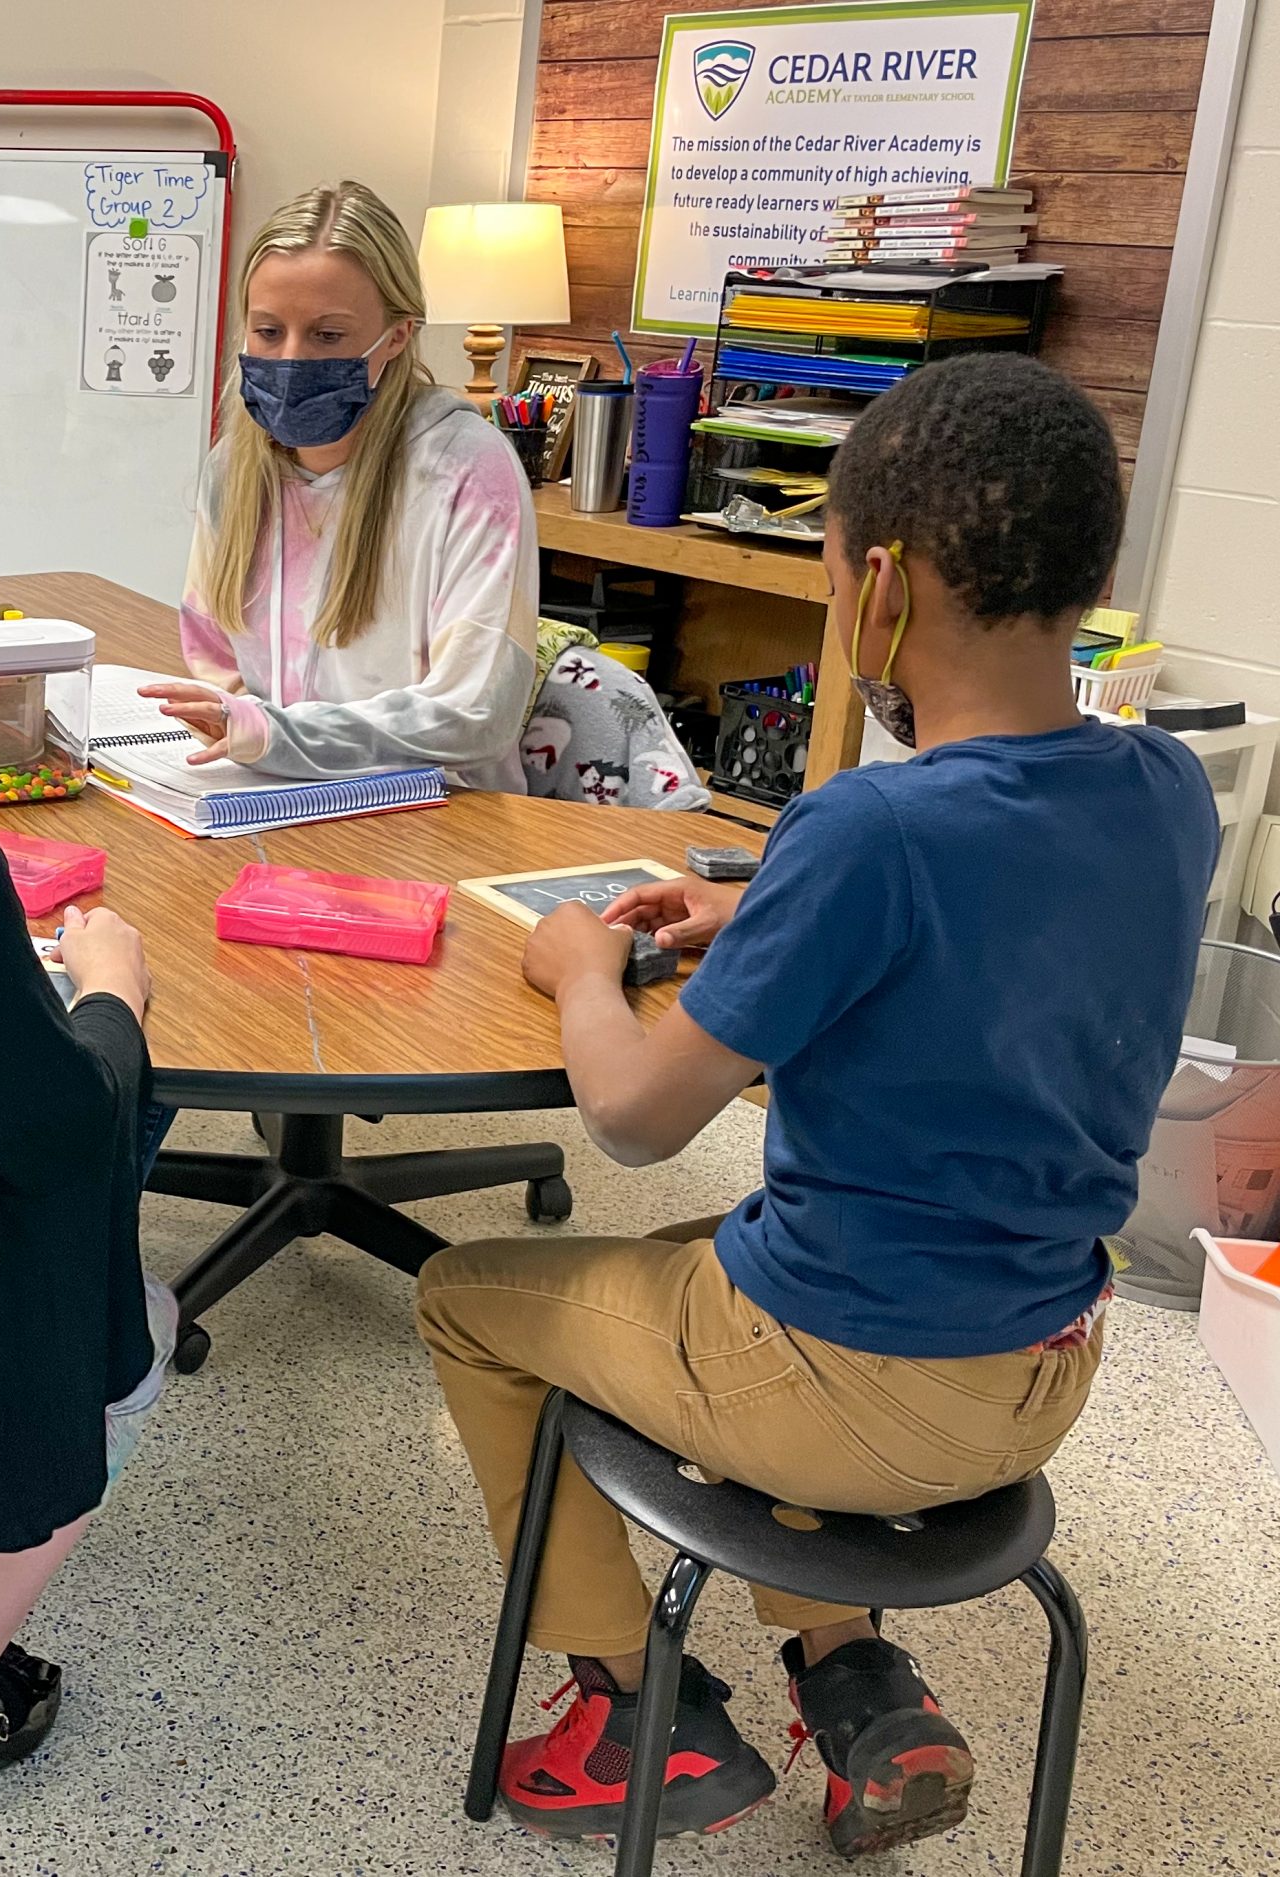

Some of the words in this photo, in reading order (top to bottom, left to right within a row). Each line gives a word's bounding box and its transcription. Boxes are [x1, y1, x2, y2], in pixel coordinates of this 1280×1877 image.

[768, 52, 873, 84] CEDAR
[881, 49, 978, 81] RIVER
[765, 88, 842, 104] ACADEMY
[842, 95, 852, 103] AT
[853, 94, 884, 103] TAYLOR
[886, 93, 938, 102] ELEMENTARY
[940, 92, 976, 101] SCHOOL
[672, 136, 694, 151] The
[697, 136, 749, 151] mission
[752, 135, 767, 151] of
[770, 135, 792, 151] the
[795, 135, 840, 151] Cedar
[844, 135, 886, 151] River
[888, 135, 964, 156] Academy
[966, 134, 981, 151] is
[95, 165, 144, 195] Tiger
[153, 169, 194, 189] Time
[671, 165, 683, 180] to
[686, 165, 737, 184] develop
[740, 170, 748, 181] a
[751, 166, 833, 186] community
[836, 166, 852, 182] of
[854, 166, 887, 186] high
[100, 197, 152, 217] Group
[163, 199, 174, 218] 2
[673, 193, 713, 209] future
[715, 194, 754, 213] ready
[757, 194, 819, 211] learners
[690, 221, 710, 237] the
[713, 222, 807, 244] sustainability
[809, 225, 825, 241] of
[158, 238, 166, 251] G
[118, 312, 150, 326] Hard
[154, 313, 162, 326] G
